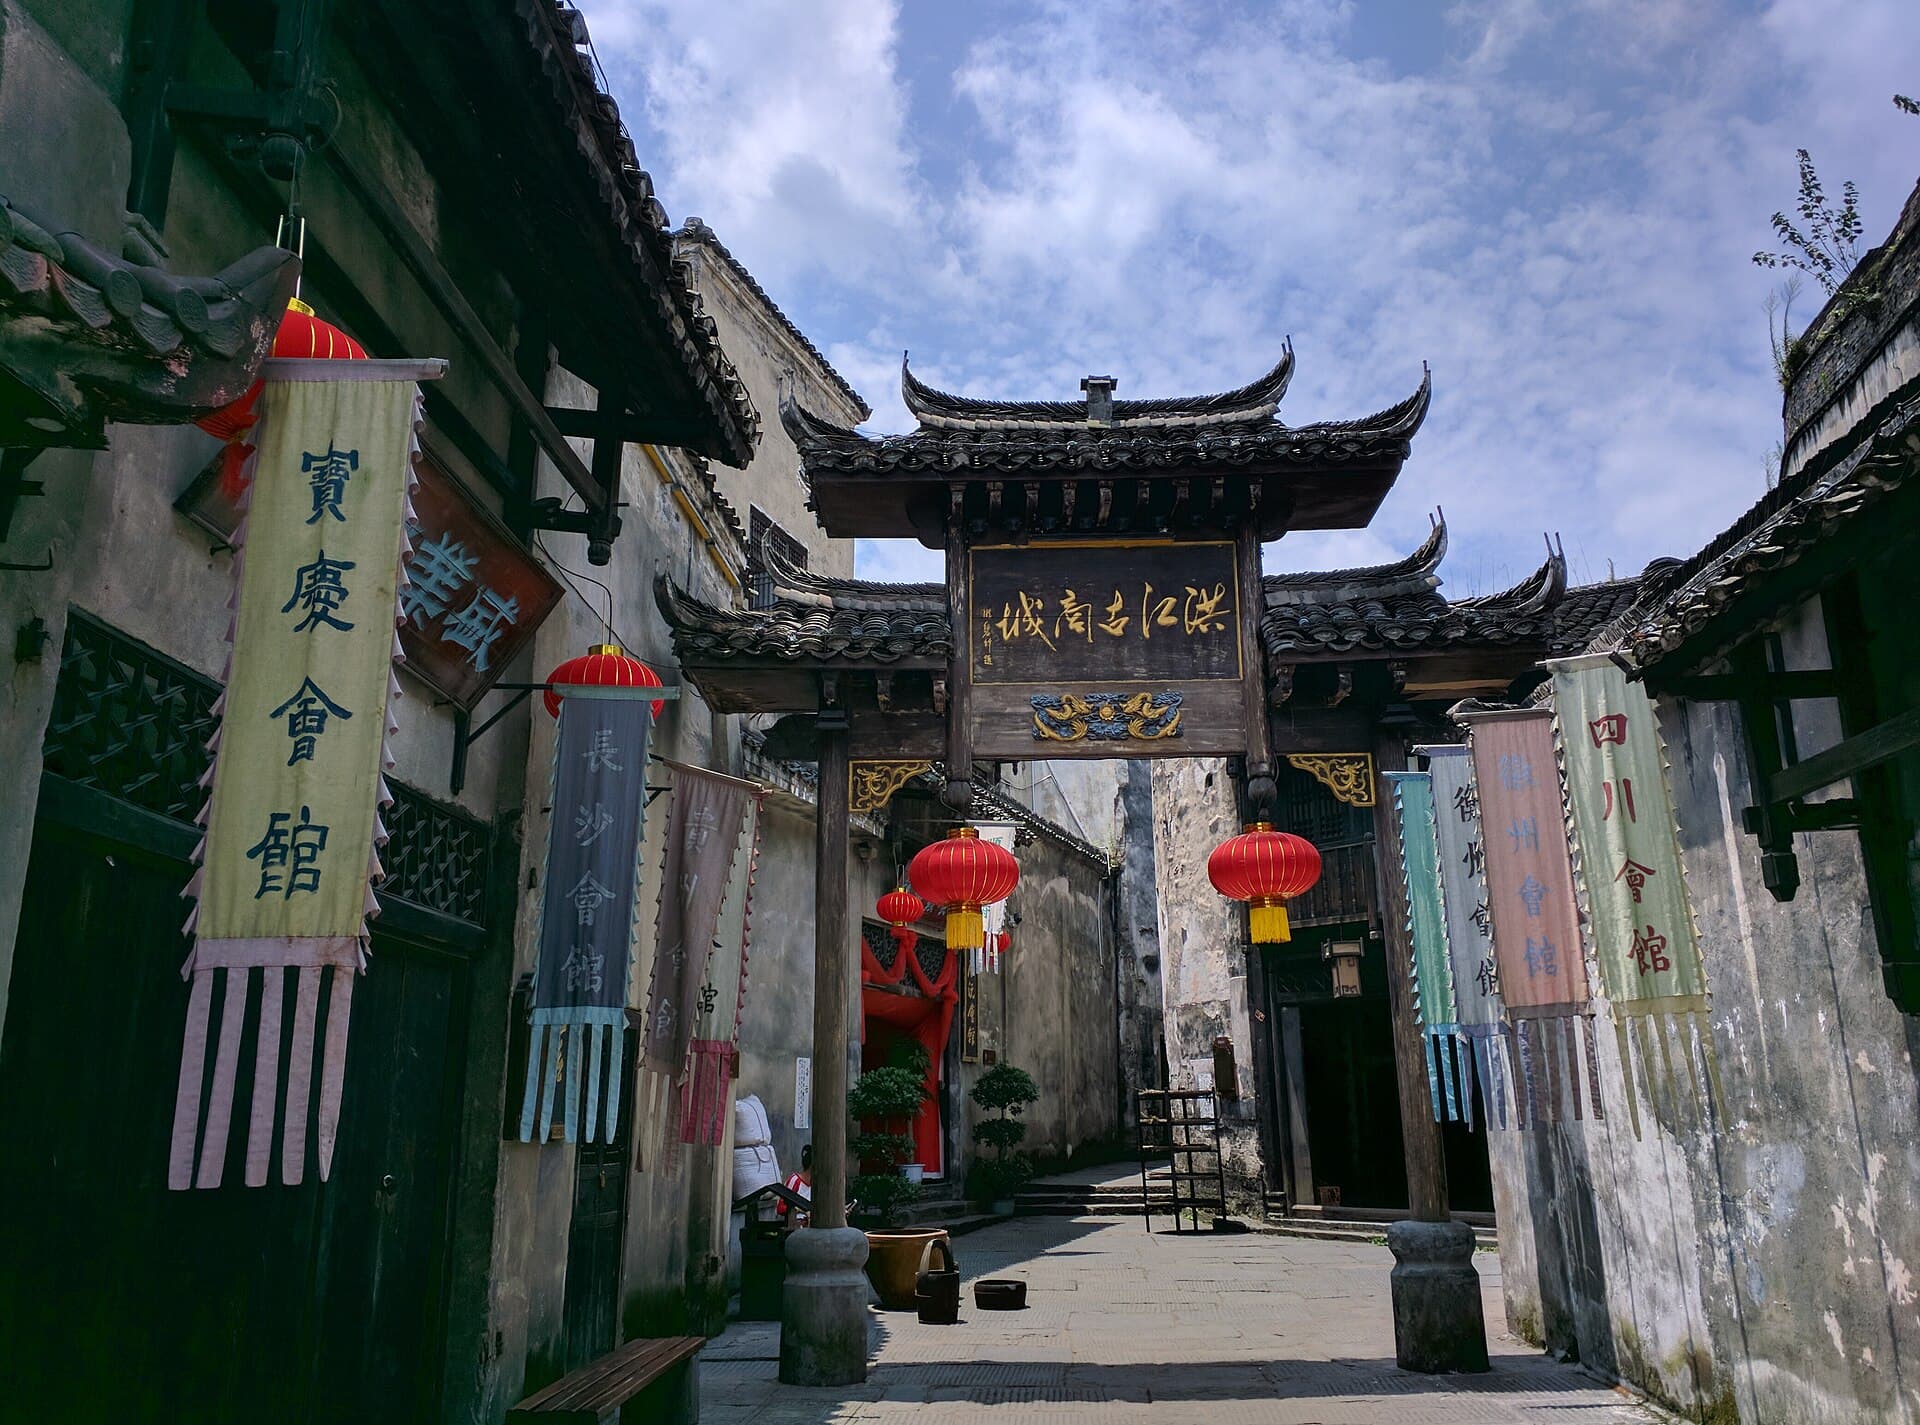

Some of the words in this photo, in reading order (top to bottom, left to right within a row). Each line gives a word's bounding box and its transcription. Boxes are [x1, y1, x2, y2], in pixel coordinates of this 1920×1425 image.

[246, 439, 359, 899] 寶慶會館
[996, 582, 1230, 651] 洪江古商城
[560, 730, 624, 993] 長沙會館
[1589, 713, 1671, 976] 四川會館
